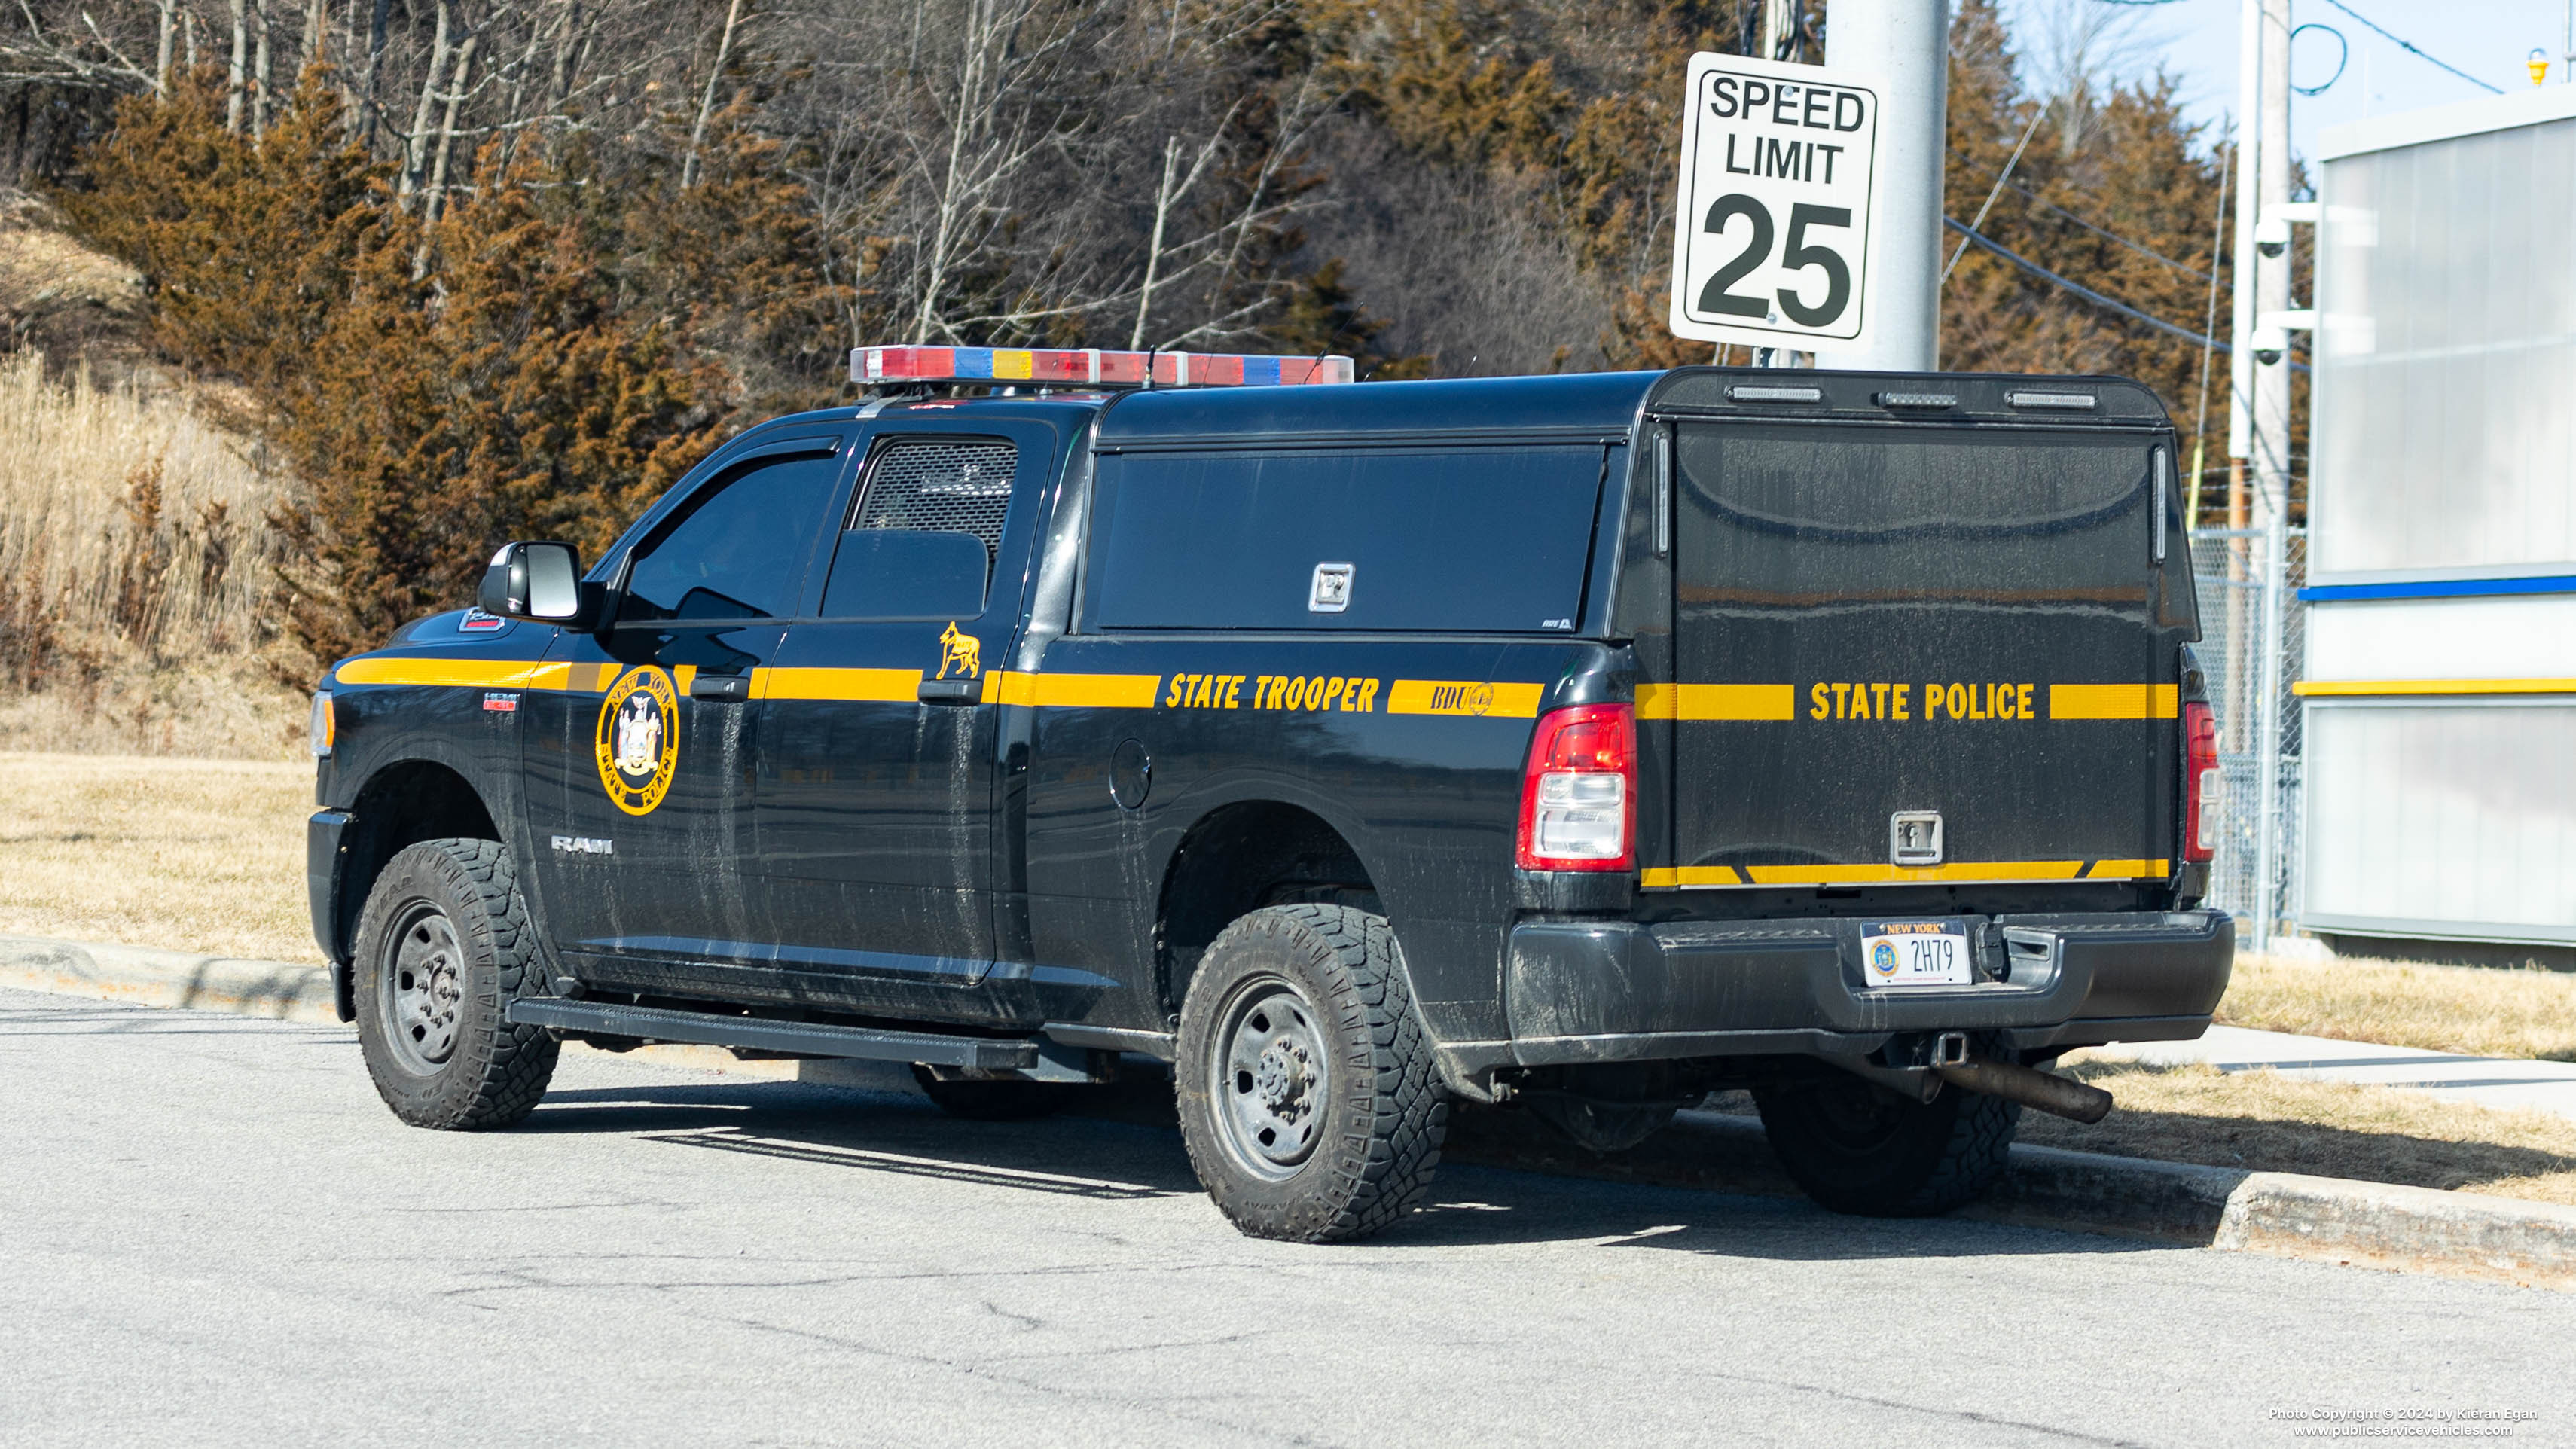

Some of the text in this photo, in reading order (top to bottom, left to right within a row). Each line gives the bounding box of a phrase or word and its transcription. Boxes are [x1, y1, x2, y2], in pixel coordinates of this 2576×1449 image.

[1711, 77, 1864, 132] SPEED
[1726, 133, 1844, 184] LIMIT
[1697, 193, 1851, 327] 25
[611, 673, 673, 715] NEW YORK
[1166, 673, 1379, 712] STATE TROOPER
[1430, 686, 1473, 710] BDU
[1810, 682, 2034, 721] STATE POLICE
[551, 835, 613, 855] RAM
[1886, 923, 1940, 934] NEW YORK
[1911, 940, 1952, 972] 2H79
